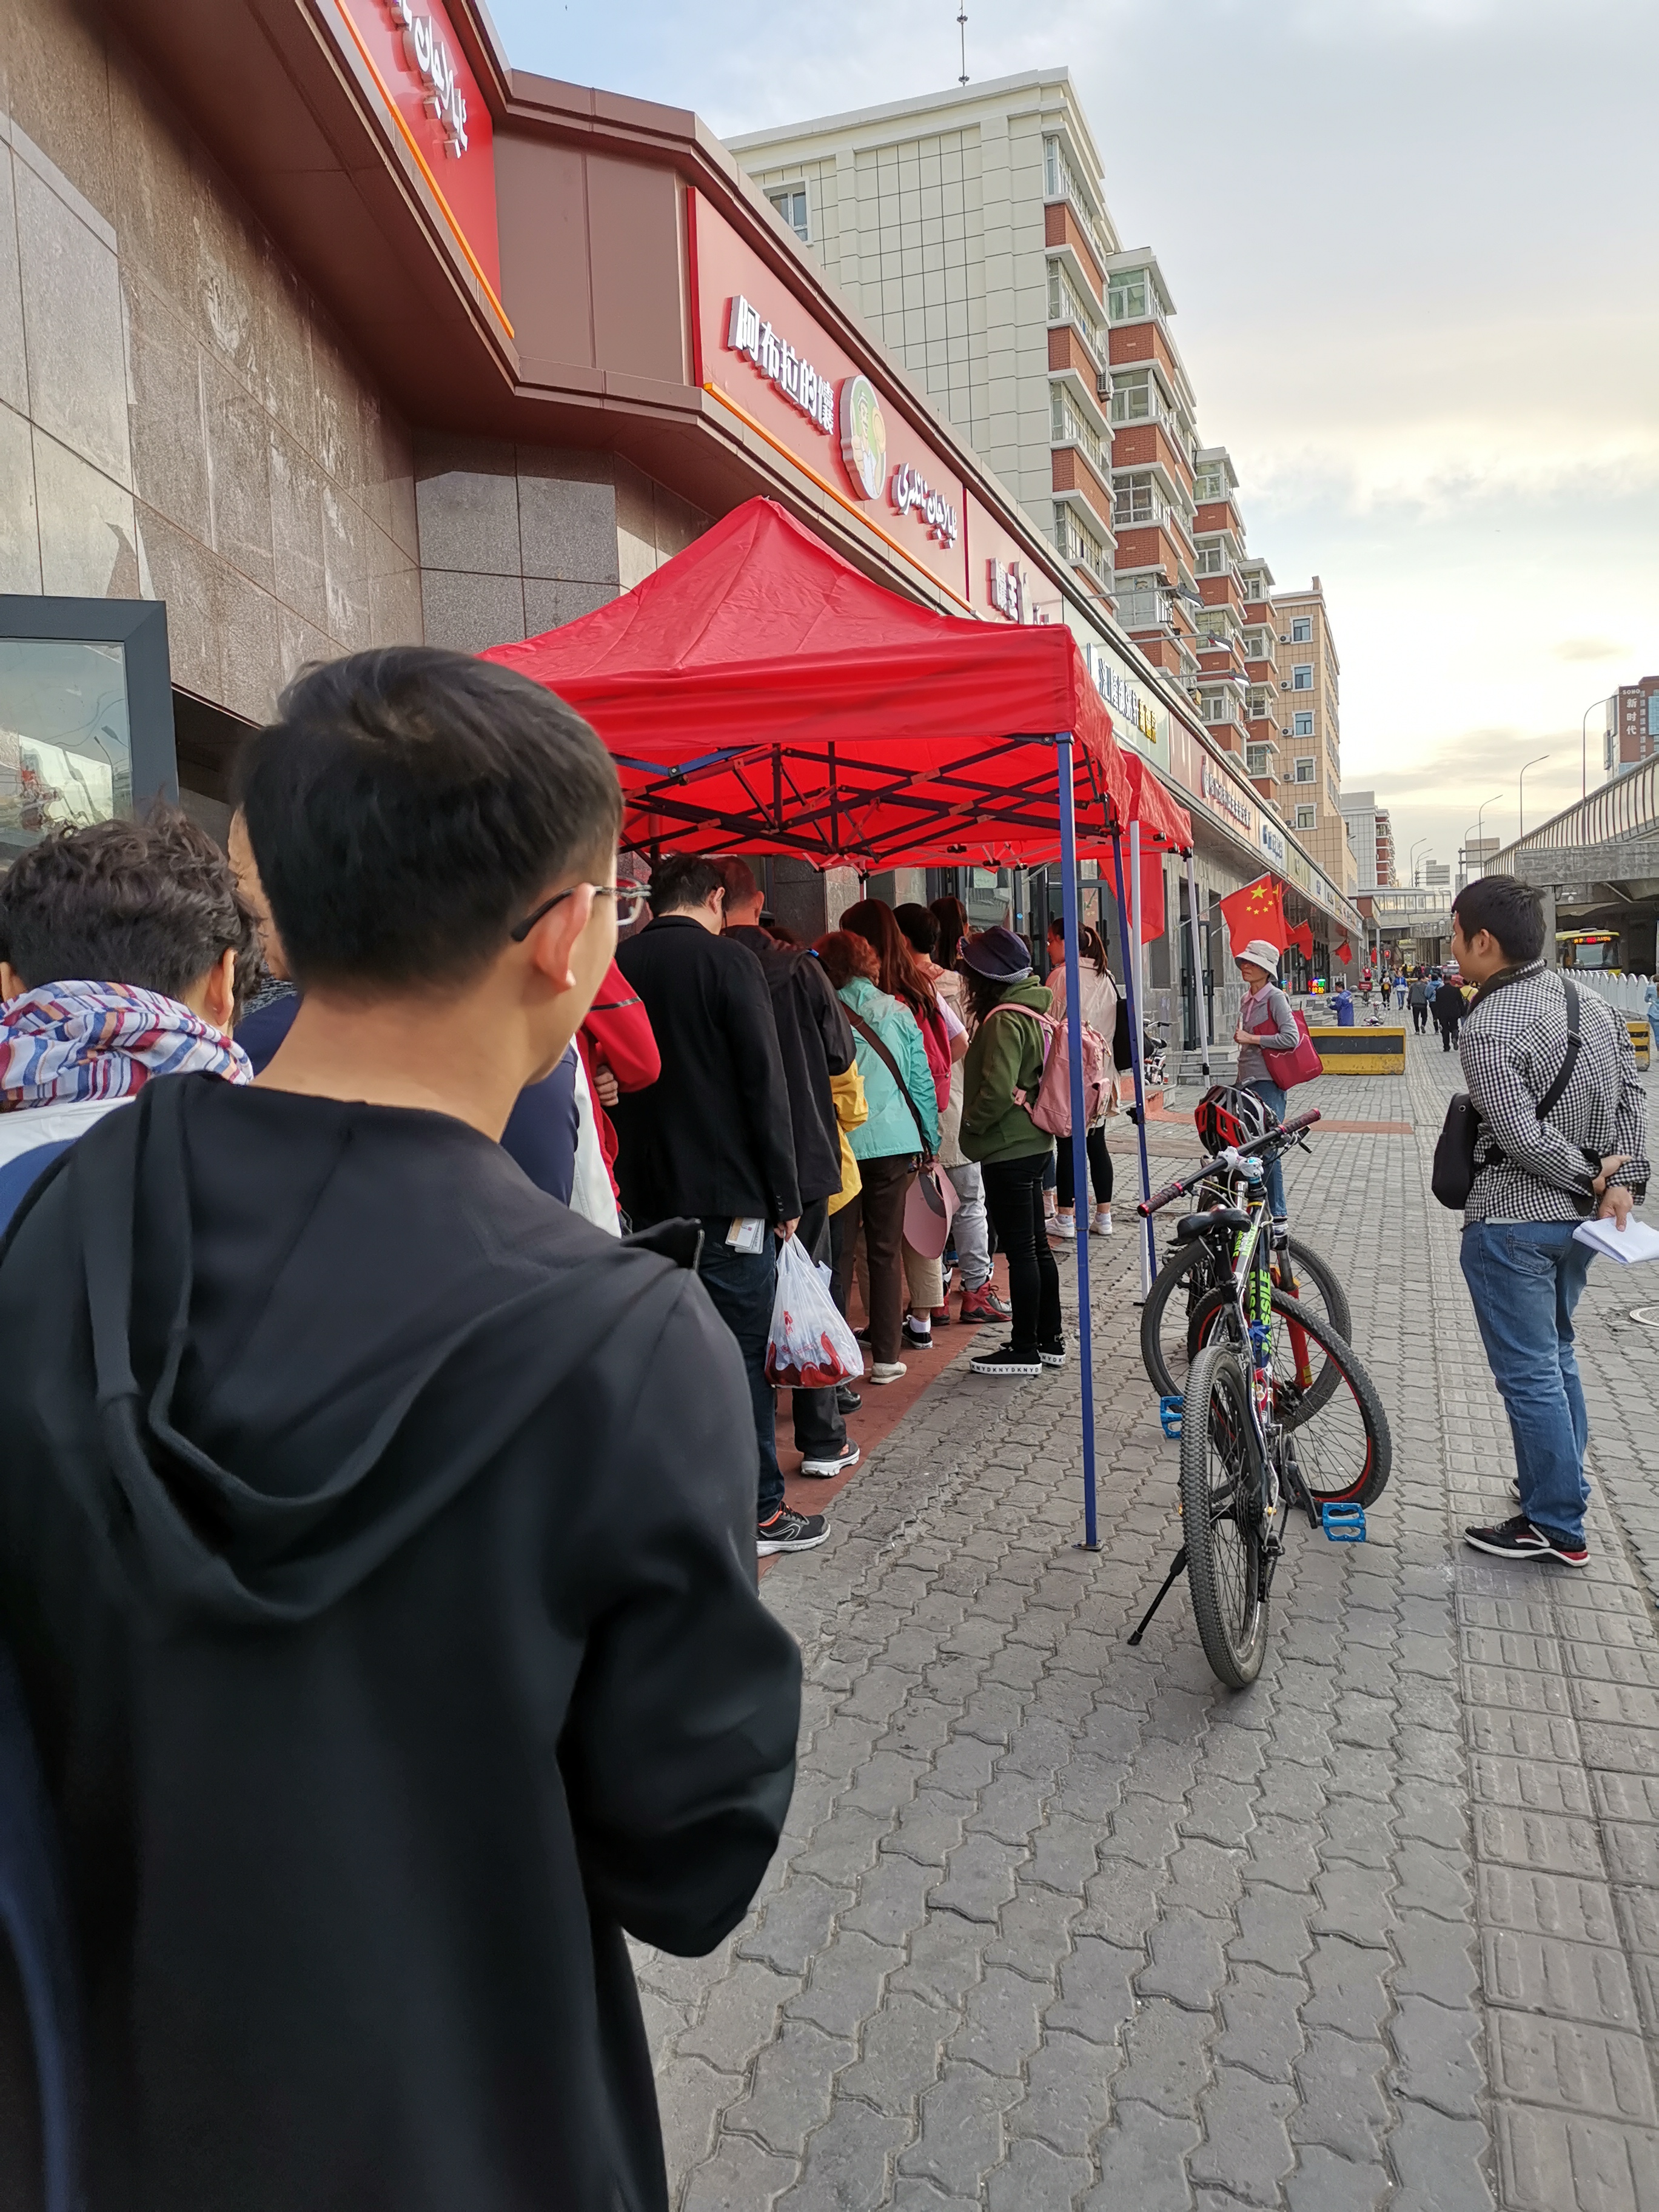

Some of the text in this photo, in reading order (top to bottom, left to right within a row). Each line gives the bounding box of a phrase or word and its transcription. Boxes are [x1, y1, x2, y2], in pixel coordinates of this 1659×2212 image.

[734, 294, 834, 435] 阿布拉的馕
[1626, 698, 1637, 736] 新时代
